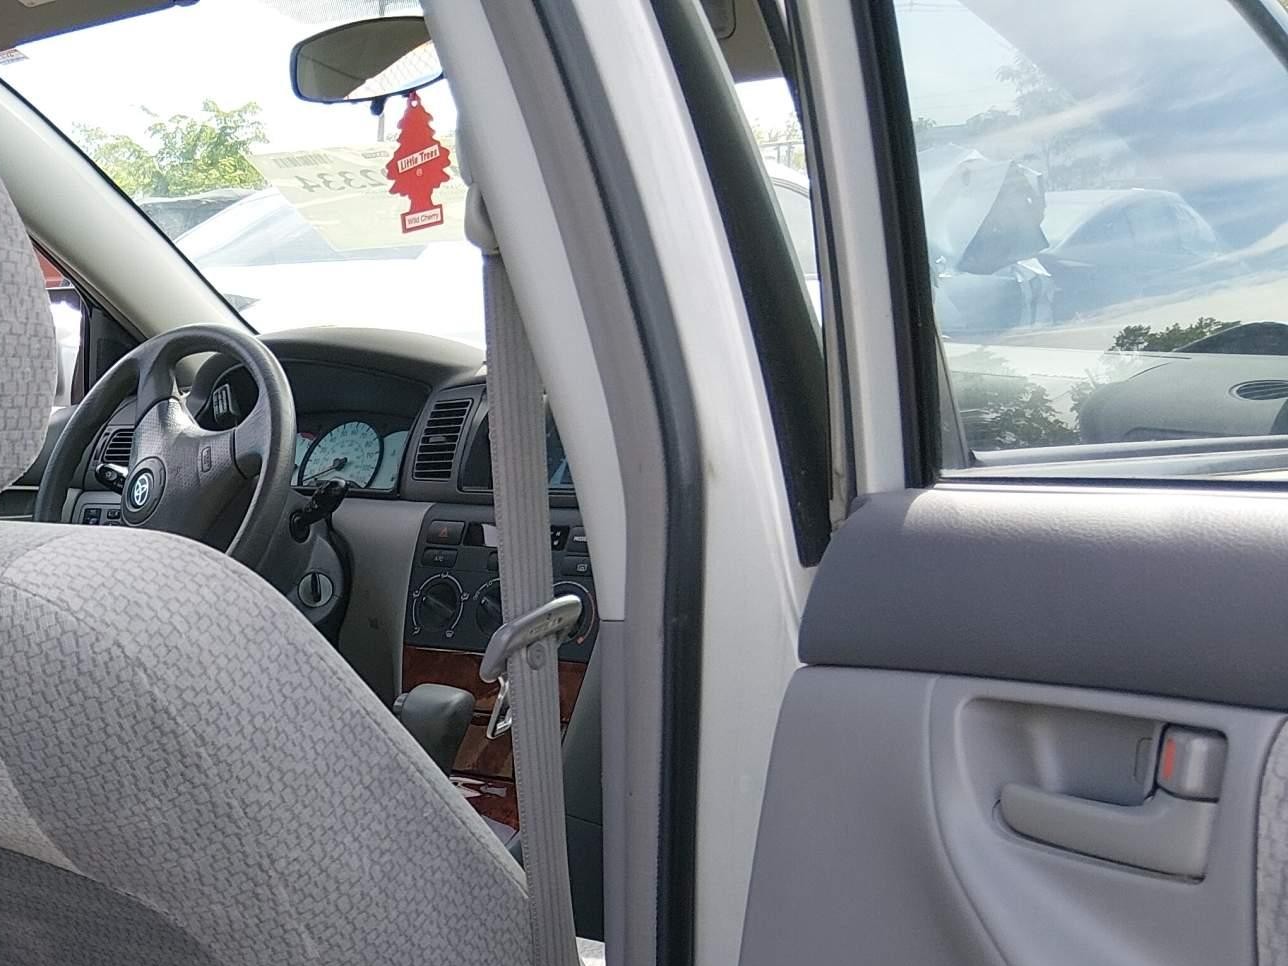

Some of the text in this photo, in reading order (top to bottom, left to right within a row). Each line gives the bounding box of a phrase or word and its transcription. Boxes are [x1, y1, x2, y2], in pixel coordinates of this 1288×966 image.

[400, 149, 438, 170] Little Trees
[408, 213, 439, 225] Wild Cherry
